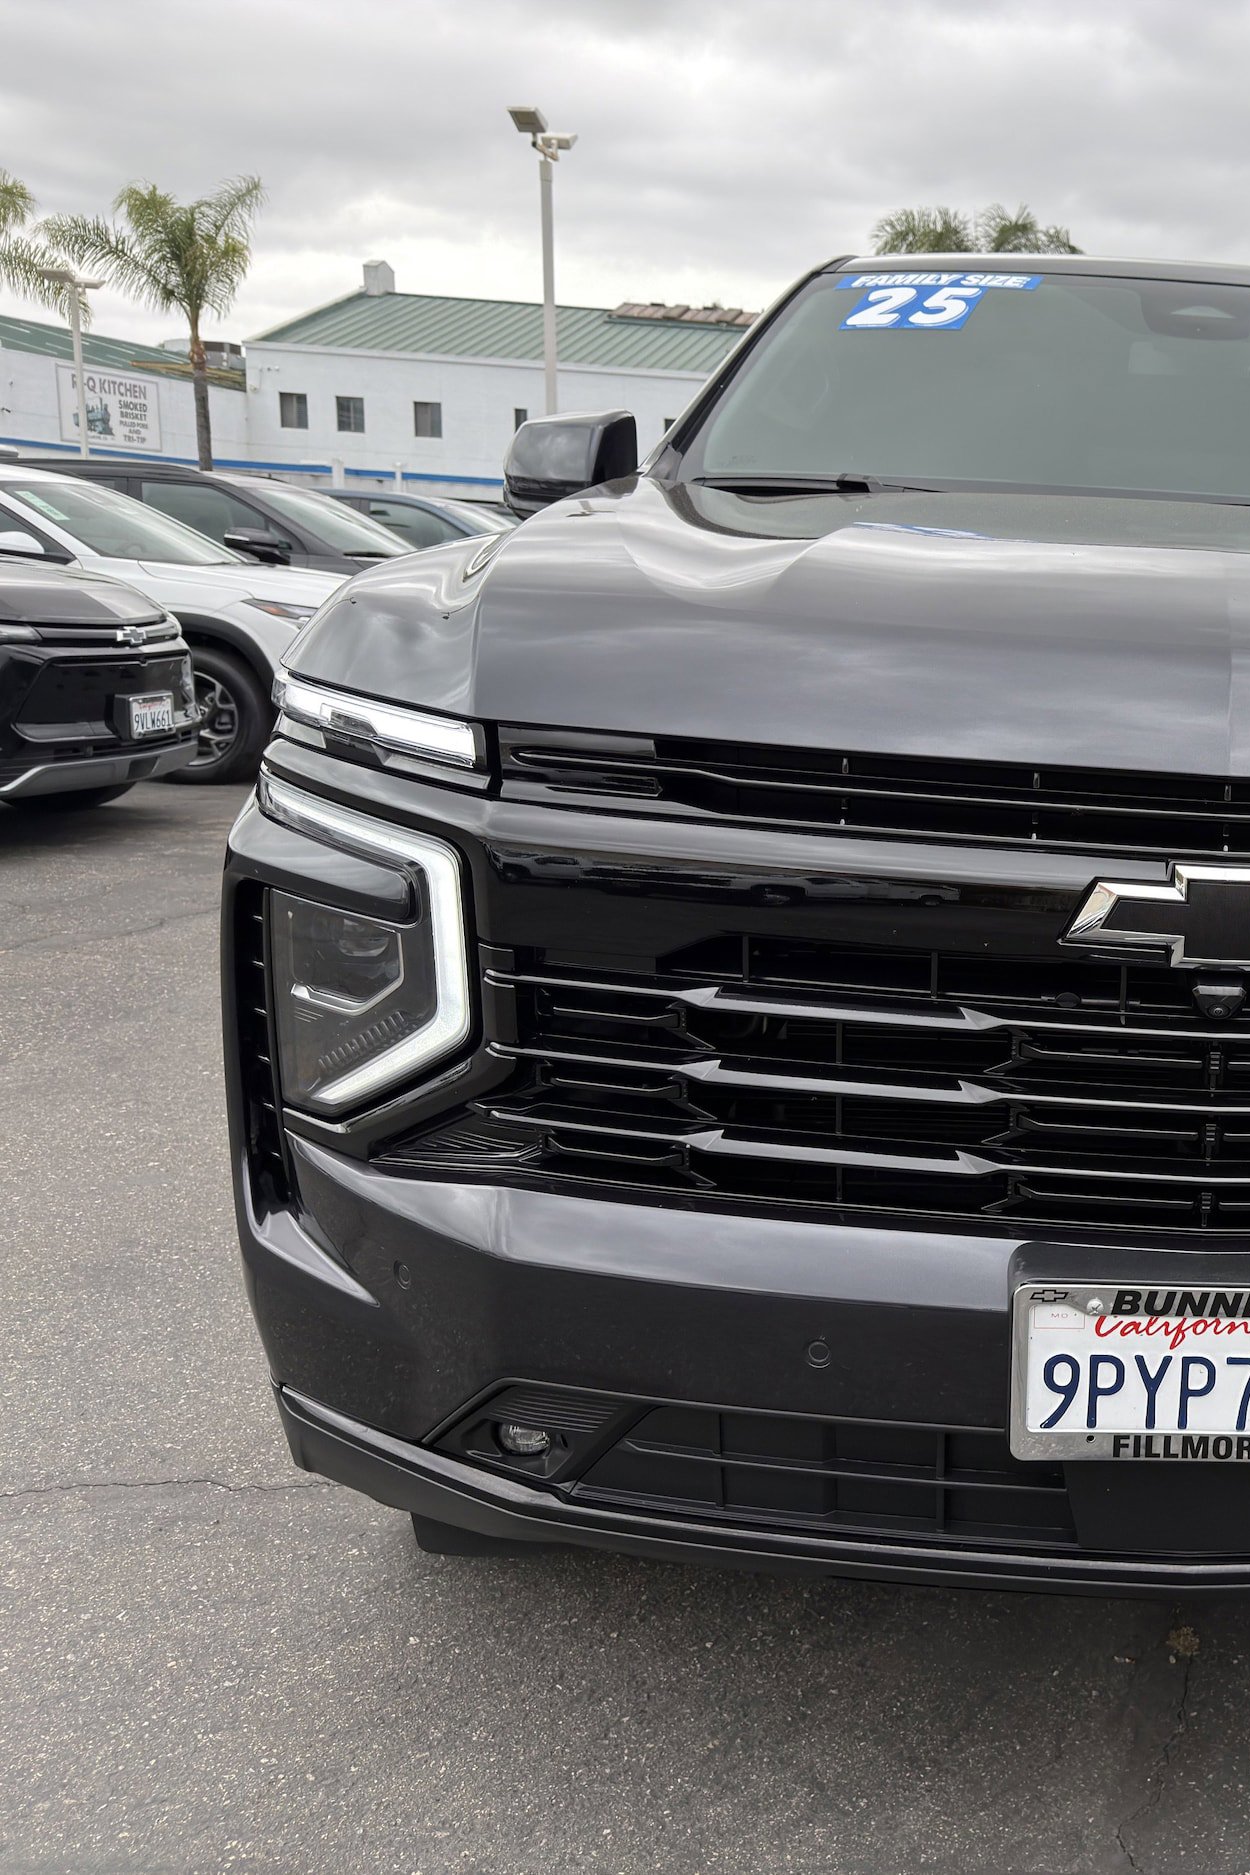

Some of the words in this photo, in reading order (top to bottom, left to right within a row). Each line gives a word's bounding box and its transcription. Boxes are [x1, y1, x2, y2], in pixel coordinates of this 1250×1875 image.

[851, 273, 960, 288] FAMILY
[960, 274, 1031, 289] SIZE
[846, 287, 982, 327] 25
[98, 377, 148, 400] KITCHEN
[118, 399, 148, 413] SMOKED
[119, 410, 147, 422] BRISKET
[135, 710, 171, 730] 9VLW661
